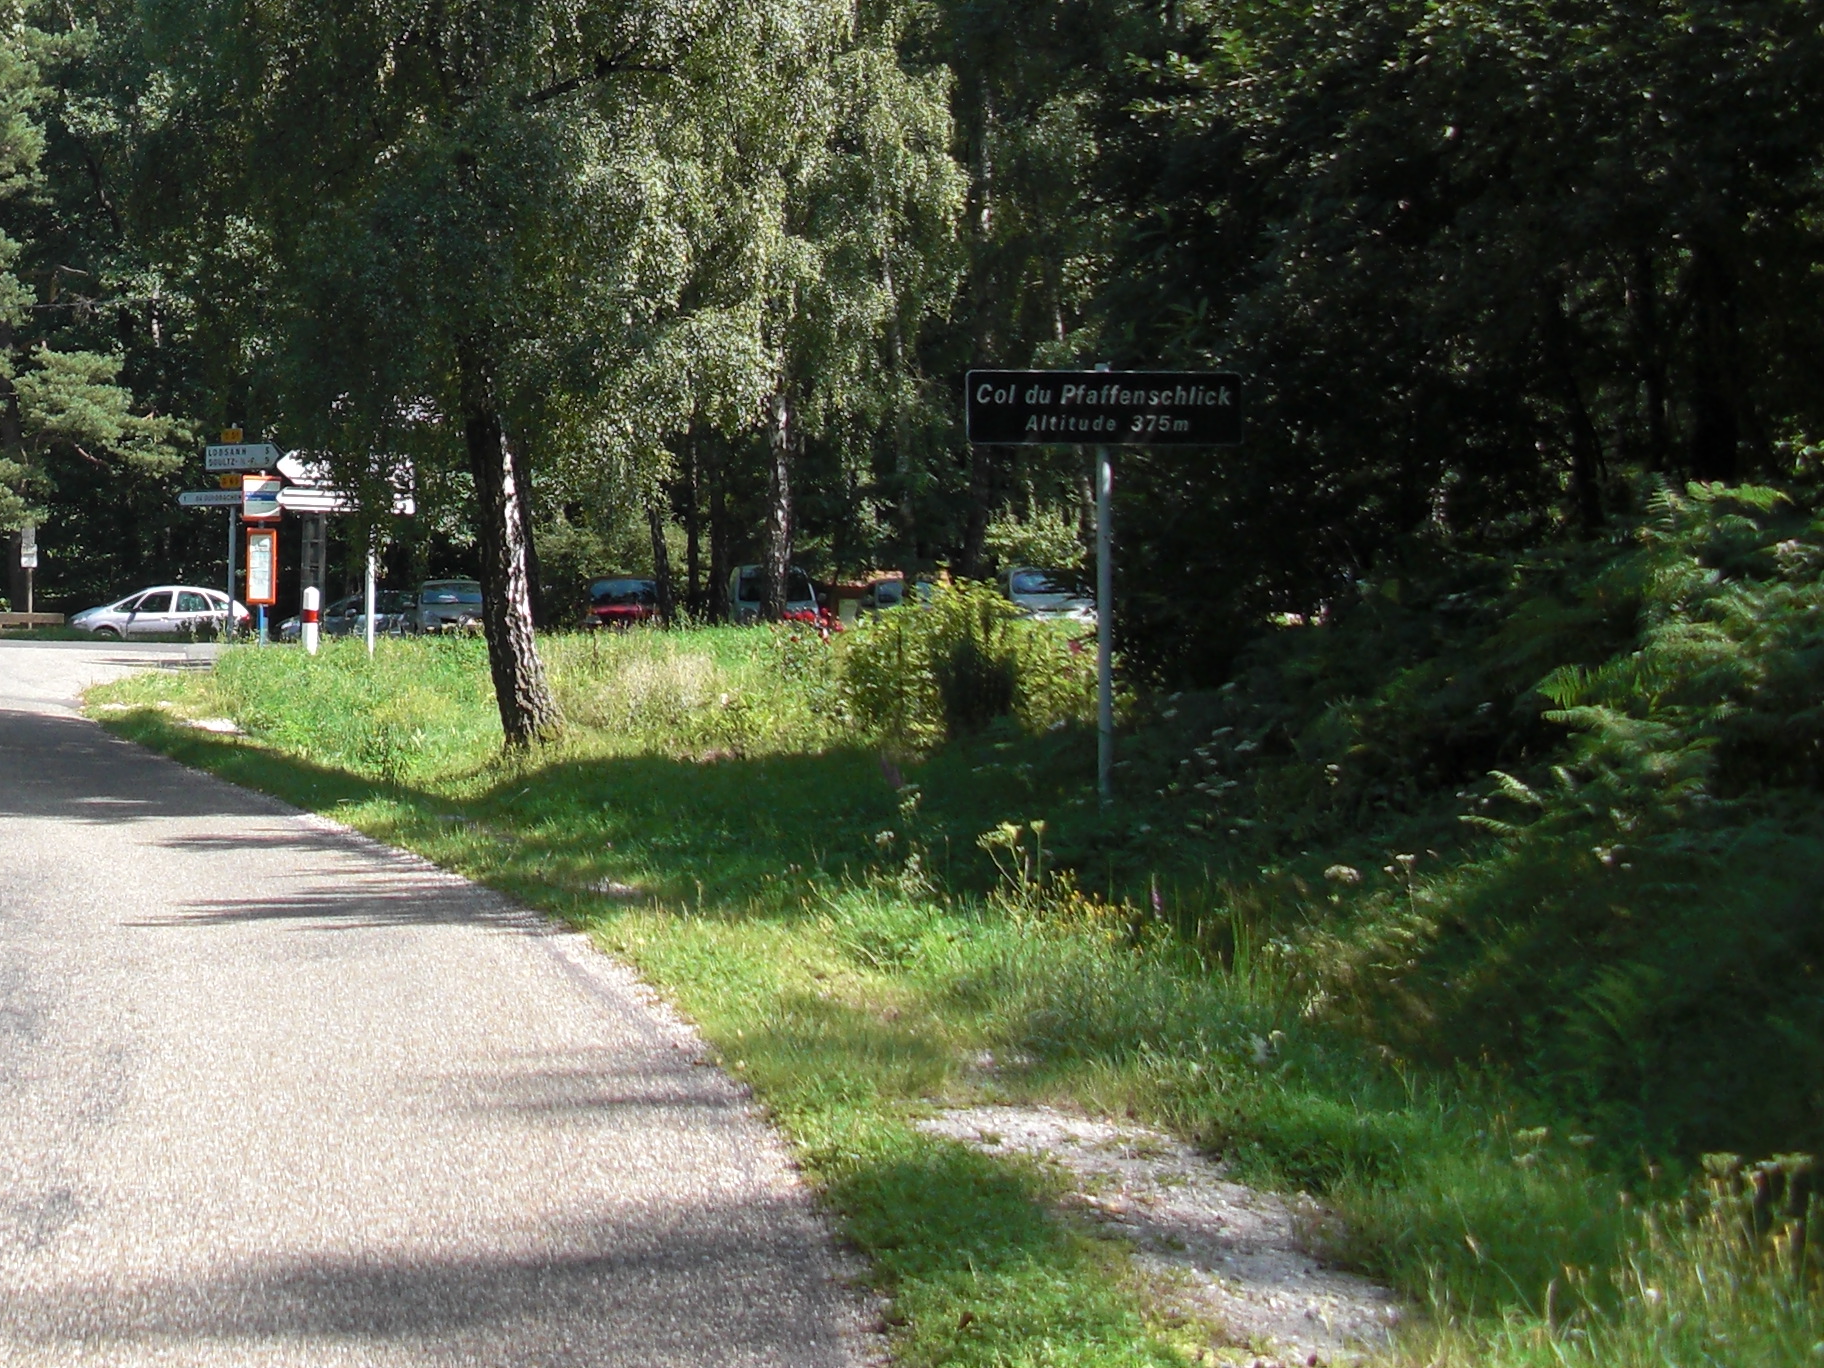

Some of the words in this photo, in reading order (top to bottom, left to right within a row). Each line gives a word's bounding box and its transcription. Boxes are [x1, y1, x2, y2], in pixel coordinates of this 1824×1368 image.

[976, 383, 1015, 405] Col
[1025, 384, 1051, 405] du
[1060, 384, 1232, 407] Pfaffenschlick
[1025, 415, 1117, 432] Altitude
